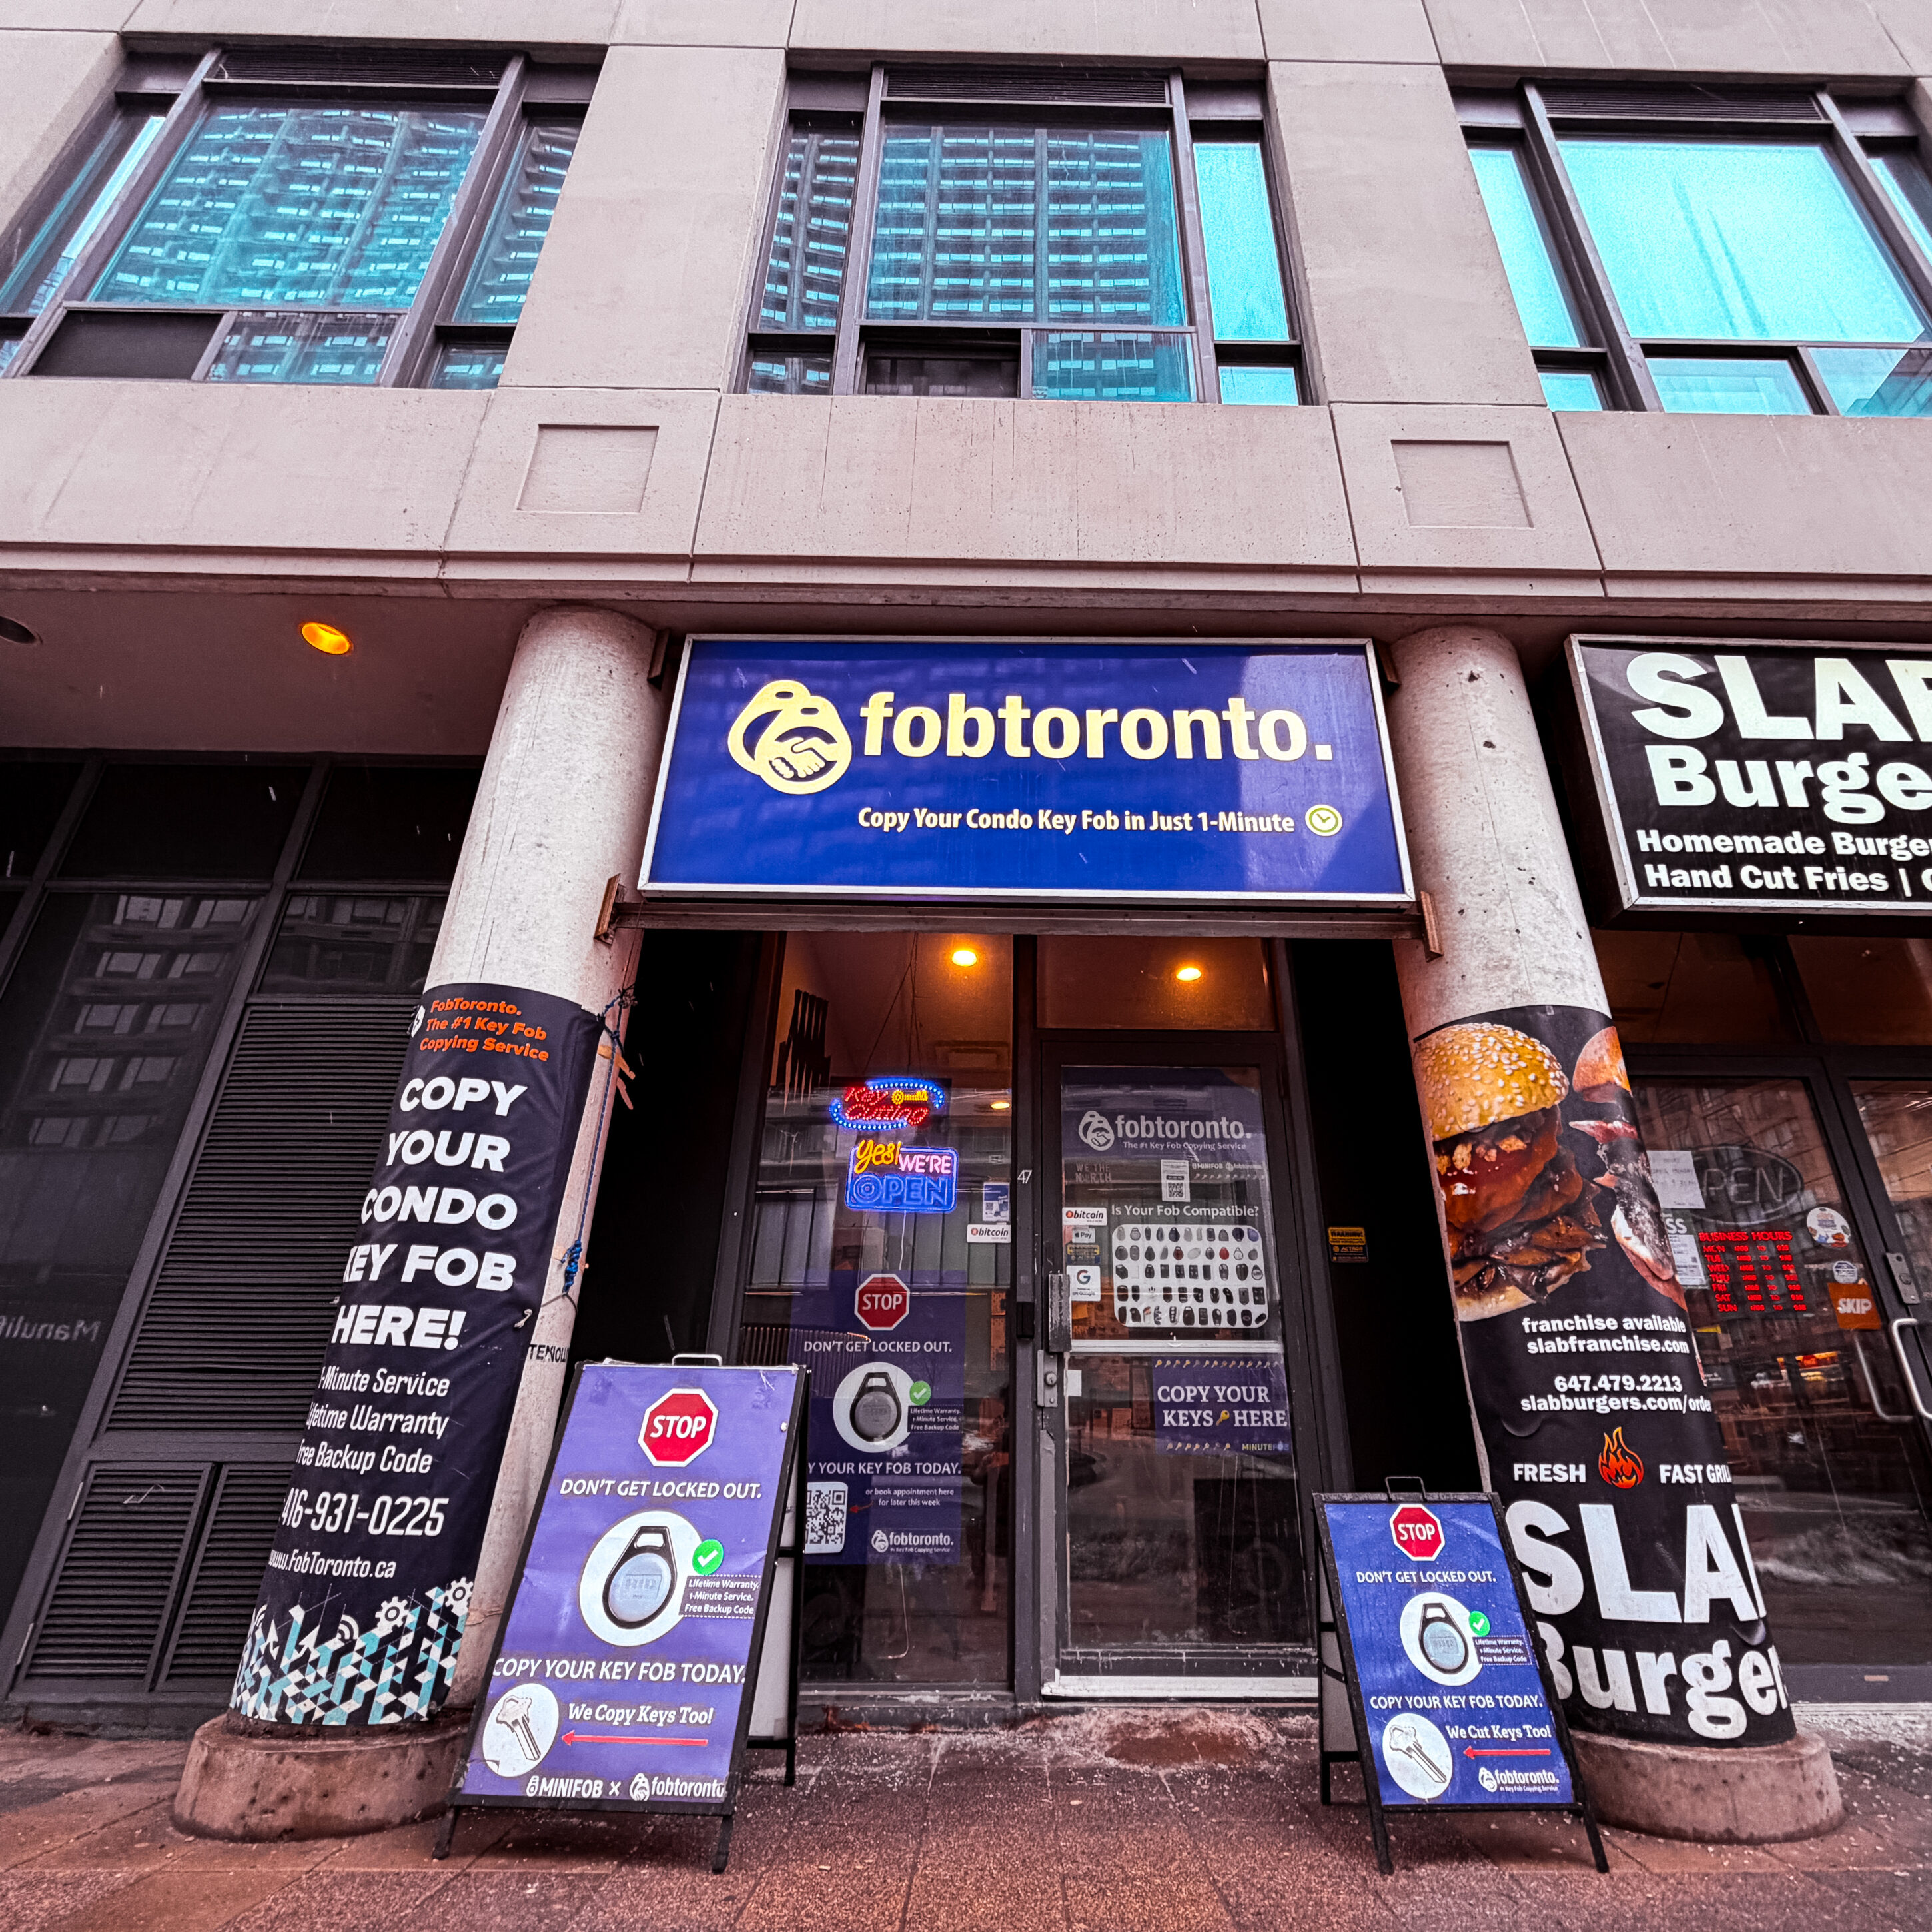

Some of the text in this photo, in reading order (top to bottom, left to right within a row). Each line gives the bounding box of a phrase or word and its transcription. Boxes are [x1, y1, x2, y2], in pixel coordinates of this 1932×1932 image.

[861, 692, 1332, 761] fobtoronto.
[1645, 745, 1932, 824] Burge
[858, 807, 1295, 835] Copy Your Condo Key Fob in Just 1-Minute
[1636, 830, 1826, 854] Homemade
[1644, 864, 1889, 891] Hand Cut Fries
[430, 998, 522, 1016] FobToronto.
[426, 1017, 546, 1040] The #1 Key Fob
[420, 1035, 549, 1061] Copying Service
[400, 1076, 528, 1117] COPY
[845, 1087, 889, 1106] Key
[1115, 1115, 1252, 1139] fobtoronto.
[386, 1130, 510, 1172] YOUR
[1150, 1142, 1165, 1151] Key
[1183, 1142, 1216, 1151] Copying
[899, 1154, 952, 1174] WE'RE
[1017, 1169, 1033, 1184] 47
[853, 1173, 948, 1206] OPEN
[361, 1185, 518, 1230] CONDO
[1073, 1210, 1104, 1219] bitcoin
[1112, 1205, 1259, 1219] Is Your Fob Compatible?
[979, 1227, 1009, 1236] bitcoin
[1699, 1231, 1793, 1242] BUSINESS HOURS
[400, 1244, 517, 1292] FOB
[1709, 1274, 1730, 1282] THU
[862, 1294, 903, 1310] STOP
[1838, 1298, 1872, 1314] SKIP
[331, 1304, 466, 1350] HERE!
[1522, 1314, 1686, 1334] franchise available
[803, 1340, 953, 1352] DON'T GET LOCKED OUT.
[1528, 1334, 1690, 1354] slabfranchise.com
[373, 1368, 450, 1397] Service
[1554, 1375, 1683, 1392] 647.479.2213
[1157, 1385, 1270, 1402] COPY YOUR
[350, 1404, 449, 1439] Warranty
[650, 1415, 706, 1438] STOP
[1163, 1410, 1288, 1428] KEYS HERE
[315, 1441, 375, 1475] Backup
[380, 1446, 432, 1474] Code
[819, 1462, 855, 1474] YOUR
[858, 1462, 883, 1474] KEY
[886, 1462, 911, 1474] FOB
[914, 1462, 961, 1474] TODAY.
[1514, 1464, 1586, 1483] FRESH
[1659, 1464, 1703, 1484] FAST
[560, 1479, 762, 1499] DON'T GET LOCKED OUT.
[893, 1488, 937, 1497] appointment
[889, 1532, 954, 1546] fobtoronto.
[1398, 1523, 1436, 1541] STOP
[1505, 1500, 1767, 1623] SLA
[688, 1578, 720, 1588] Lifetime
[1356, 1571, 1497, 1584] DON'T GET LOCKED OUT.
[690, 1591, 754, 1601] 1-Minute Service.
[684, 1603, 754, 1616] Free Backup Code
[492, 1658, 745, 1684] COPY YOUR KEY FOB TODAY.
[1536, 1622, 1788, 1739] Burge
[1370, 1695, 1543, 1709] COPY YOUR KEY FOB TODAY.
[568, 1703, 714, 1725] We Copy Keys Too!
[1446, 1725, 1552, 1741] We Cut Keys Too!
[1495, 1769, 1560, 1784] fobtoronto.
[539, 1777, 603, 1798] MINIFOB
